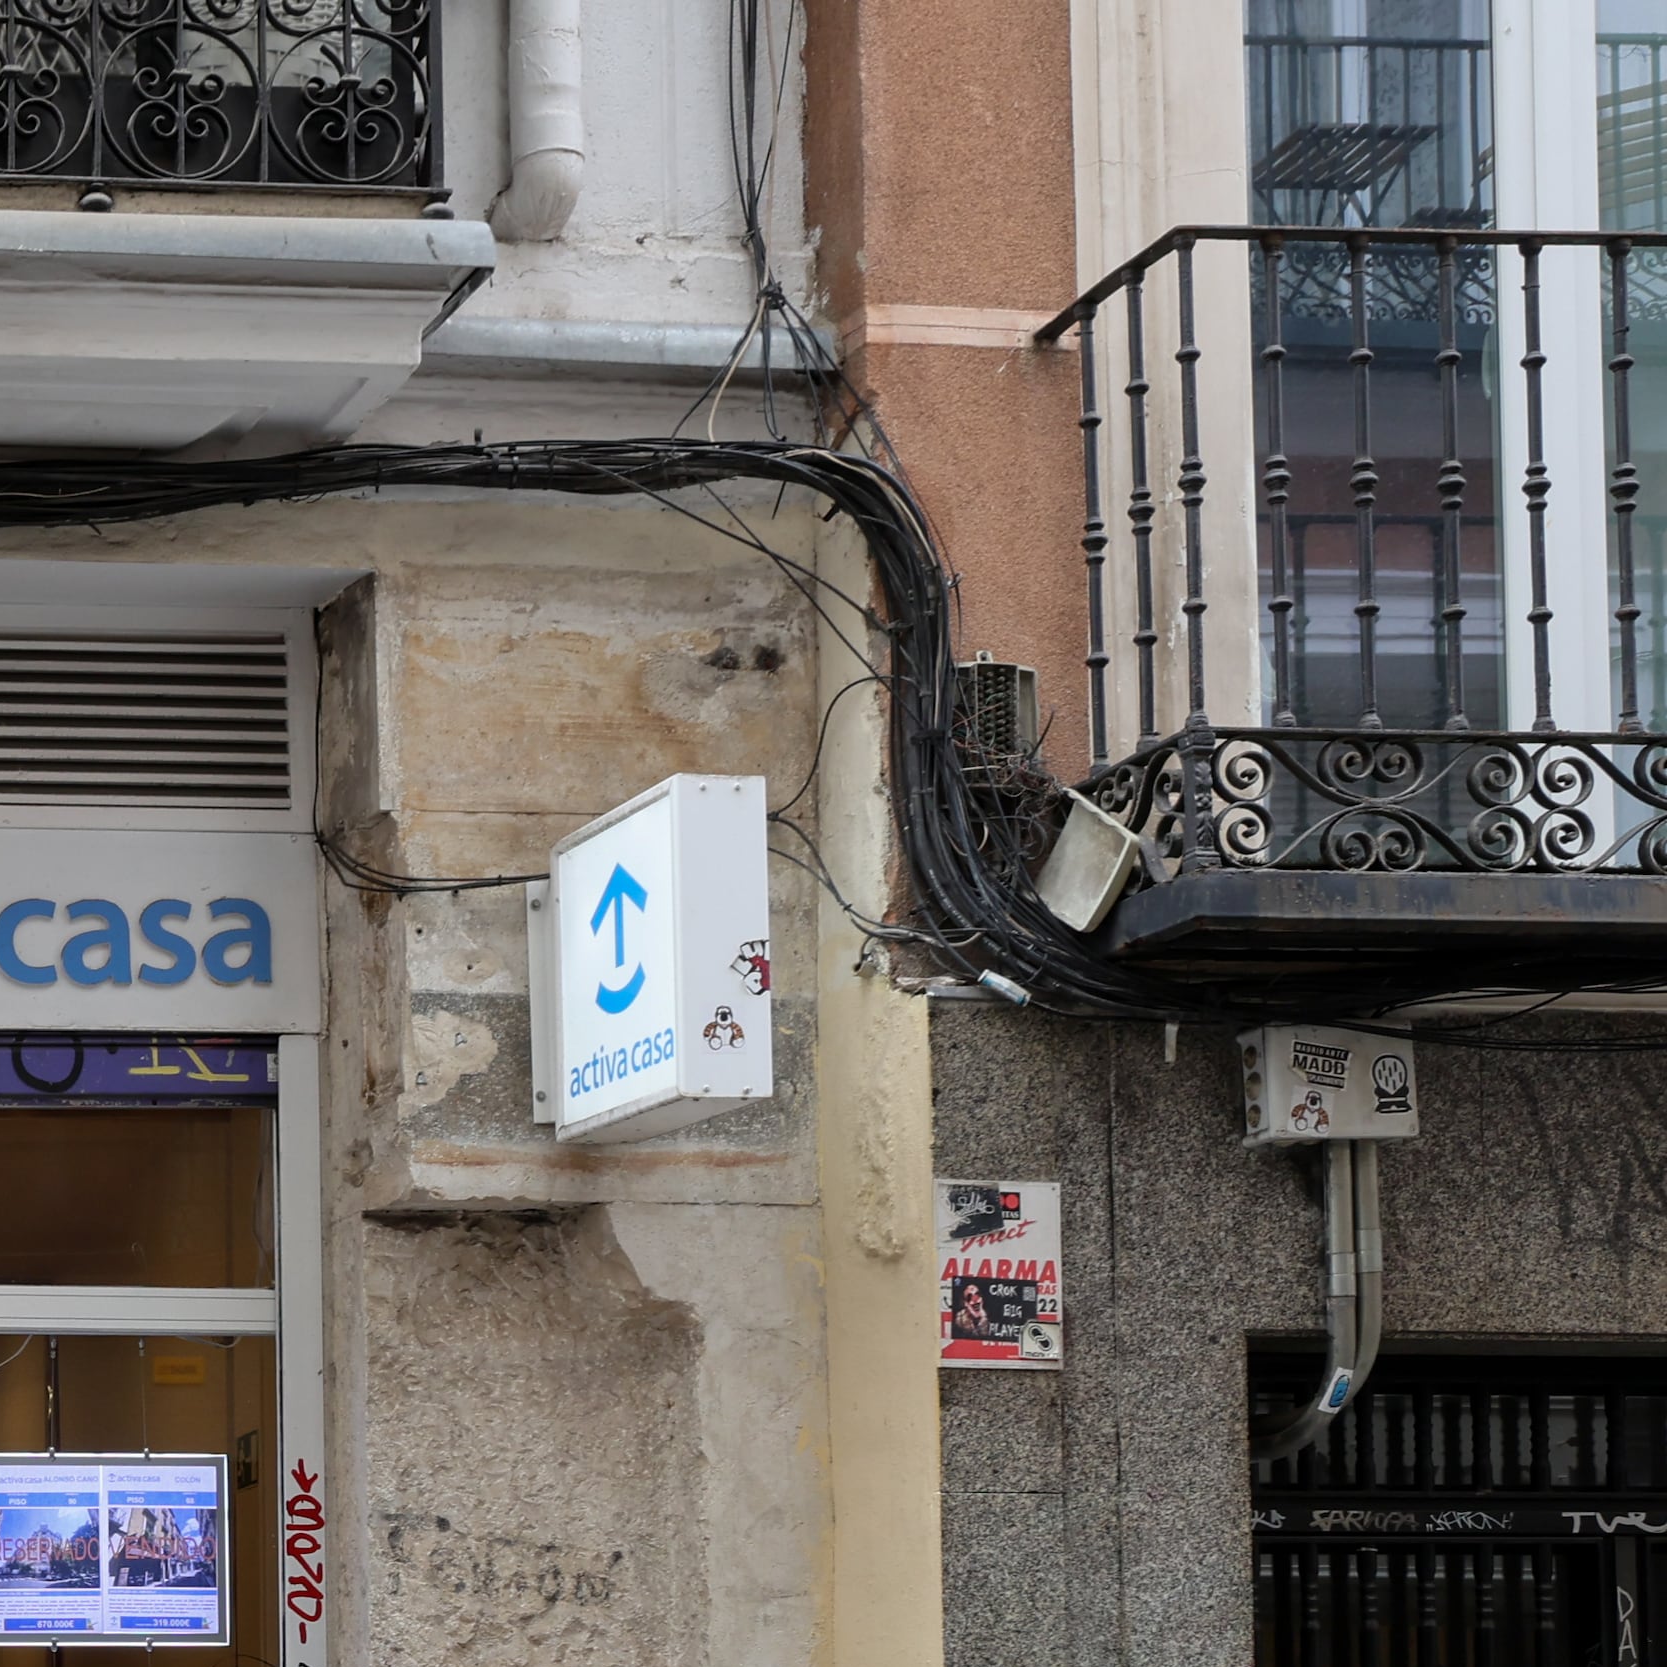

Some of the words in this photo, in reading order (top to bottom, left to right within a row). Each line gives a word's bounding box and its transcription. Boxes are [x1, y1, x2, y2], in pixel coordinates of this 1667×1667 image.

[570, 1044, 628, 1098] activa
[630, 1027, 675, 1078] casa
[1292, 1054, 1346, 1075] MADD
[940, 1257, 1057, 1283] ALARMA
[989, 1324, 1020, 1338] PLAYE
[110, 1536, 216, 1561] VENDIDO
